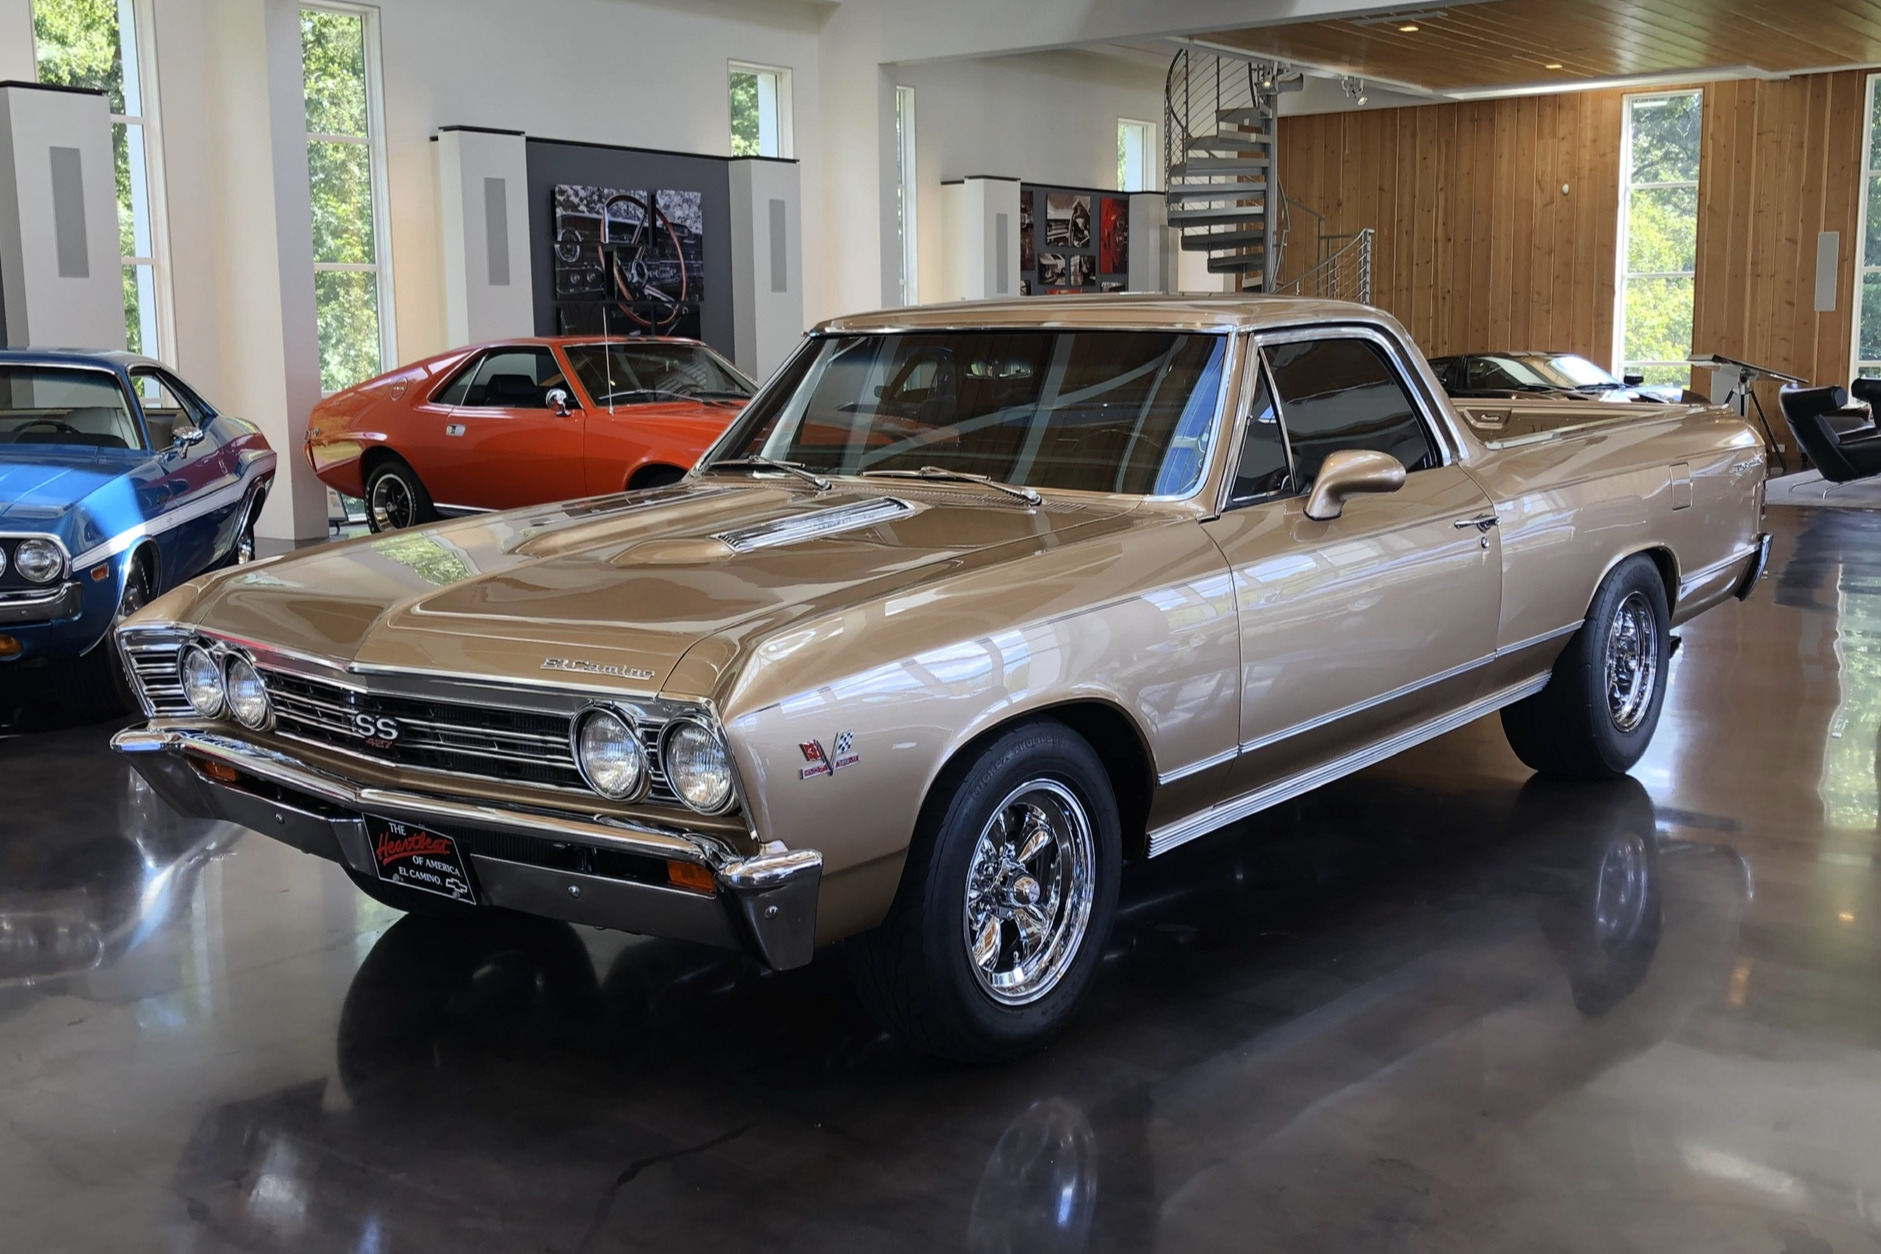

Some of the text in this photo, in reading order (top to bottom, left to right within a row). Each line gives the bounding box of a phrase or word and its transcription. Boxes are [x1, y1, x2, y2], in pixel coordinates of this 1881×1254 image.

[571, 660, 656, 678] Camino
[355, 714, 399, 740] SS
[388, 822, 406, 836] THE
[376, 831, 452, 861] Heartbeat
[398, 866, 409, 877] EL
[412, 855, 461, 877] OF AMERICA
